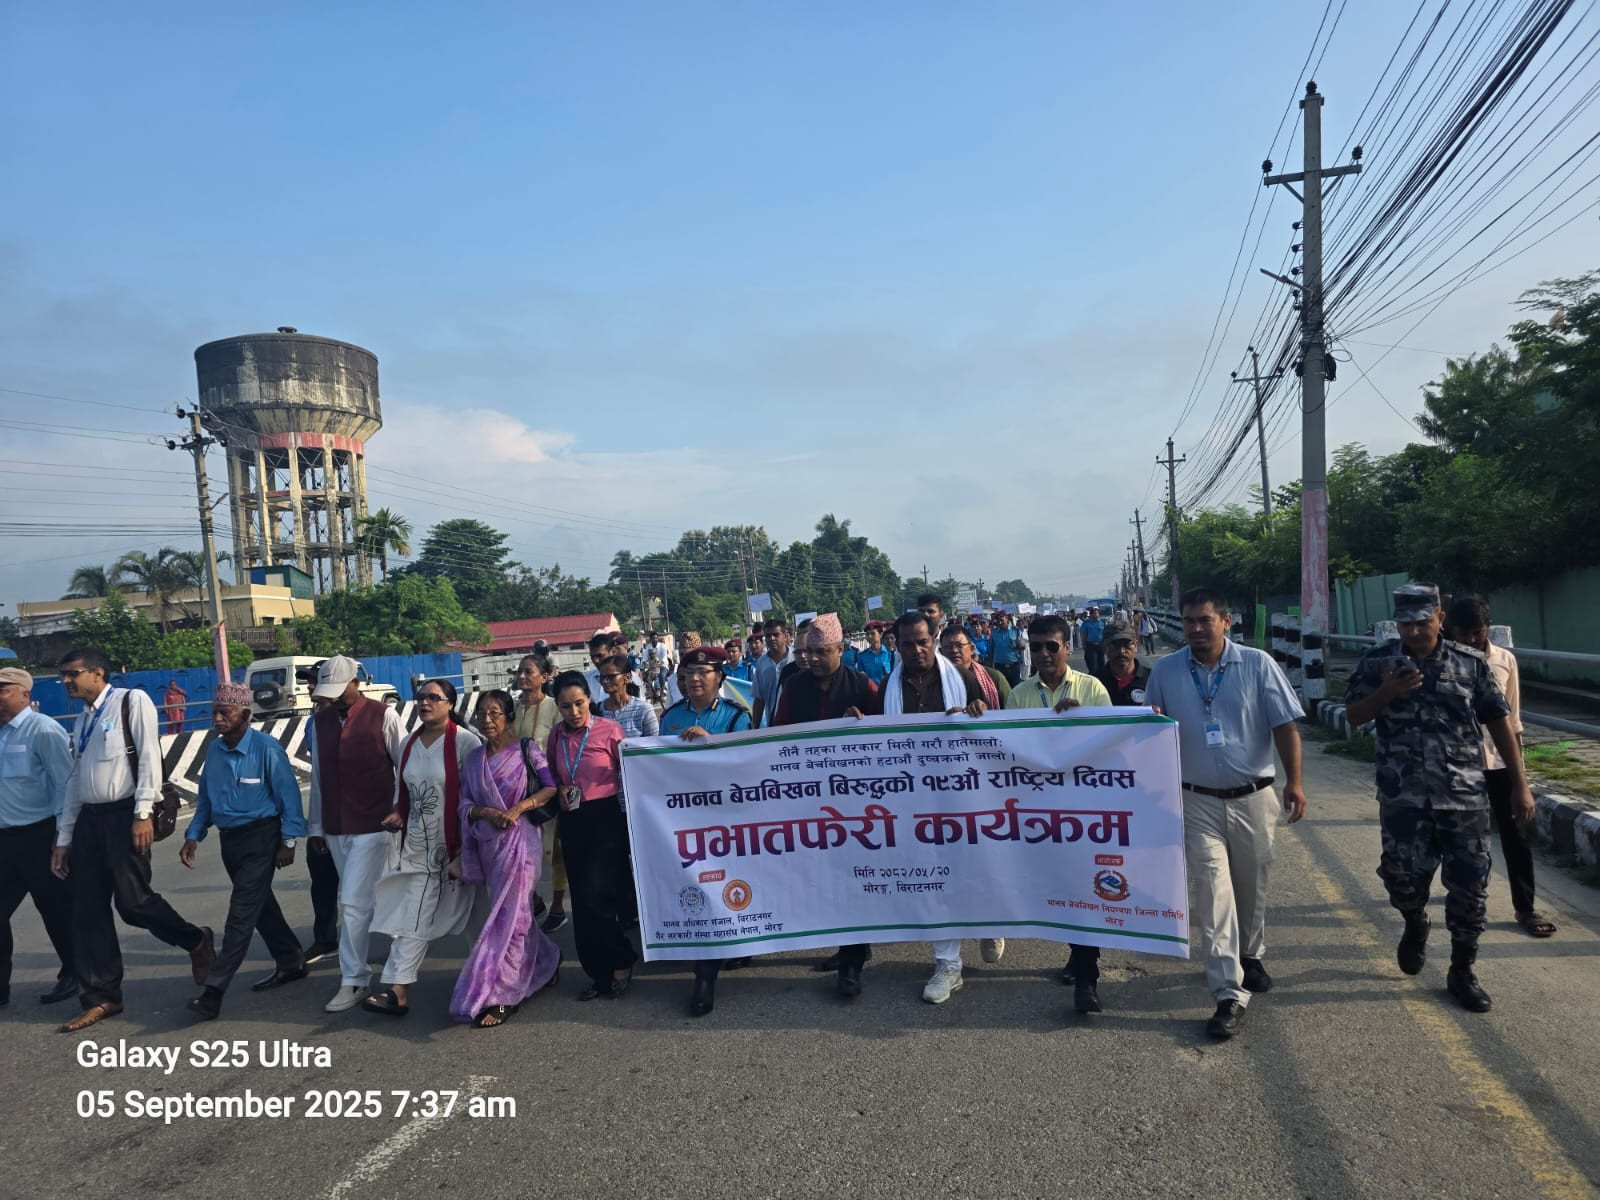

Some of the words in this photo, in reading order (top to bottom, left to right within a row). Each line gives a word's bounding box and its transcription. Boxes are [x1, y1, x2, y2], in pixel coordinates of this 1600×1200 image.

[805, 745, 836, 757] तहका
[841, 742, 883, 753] सरकार
[887, 738, 916, 751] मिली
[665, 789, 723, 809] मानव
[729, 778, 822, 804] बेचबिखन
[987, 765, 1066, 791] राष्ट्रिय
[1073, 765, 1136, 789] दिवस
[674, 804, 899, 868] प्रभातफेरी
[913, 798, 1134, 847] कार्यक्रम
[853, 865, 875, 878] मिति
[880, 865, 950, 879] २०८२/०५/२०
